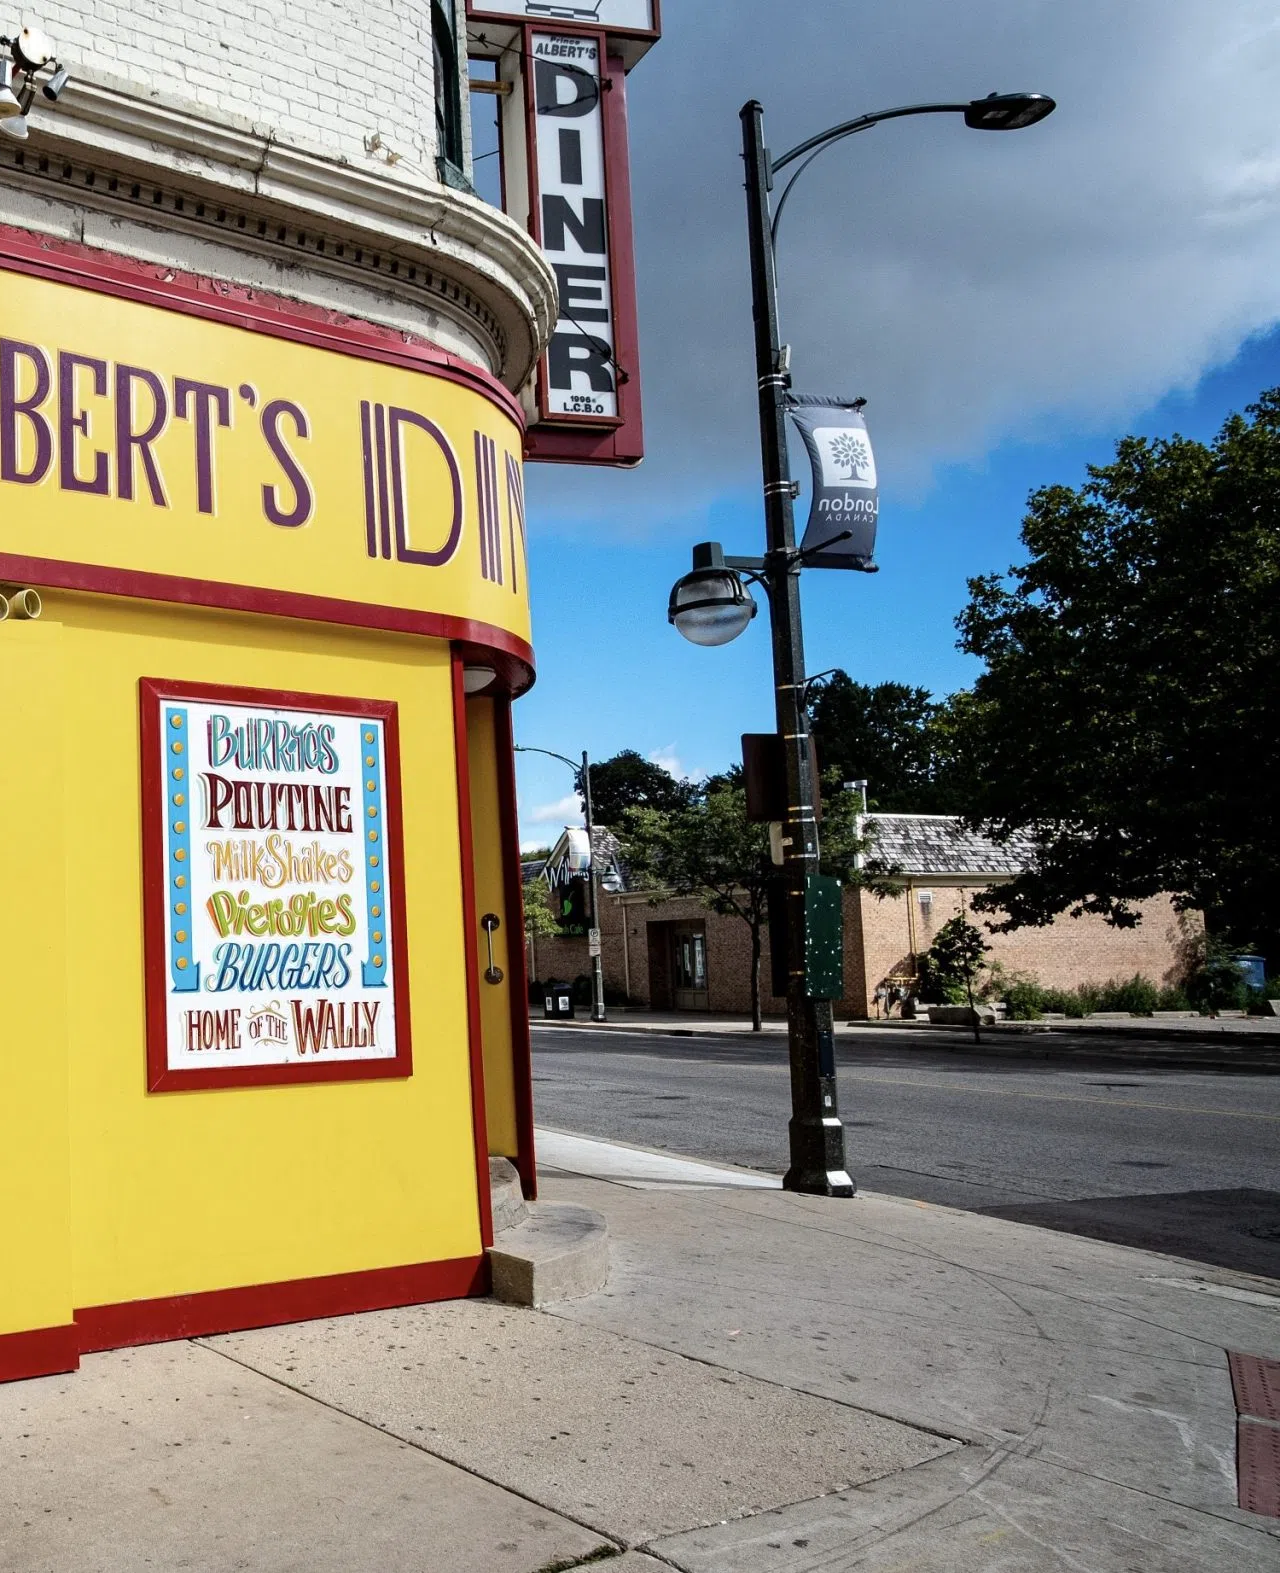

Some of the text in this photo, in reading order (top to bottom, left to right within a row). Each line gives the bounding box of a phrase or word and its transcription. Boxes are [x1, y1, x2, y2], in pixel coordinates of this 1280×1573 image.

[535, 42, 597, 60] ALBERT'S
[535, 60, 615, 392] DINER
[563, 402, 604, 414] L.C.B.O
[200, 772, 354, 834] POUTINE
[206, 889, 357, 938] Pierogies
[205, 942, 353, 993] BURGERS
[185, 999, 381, 1057] HOME OF THE WALLY
